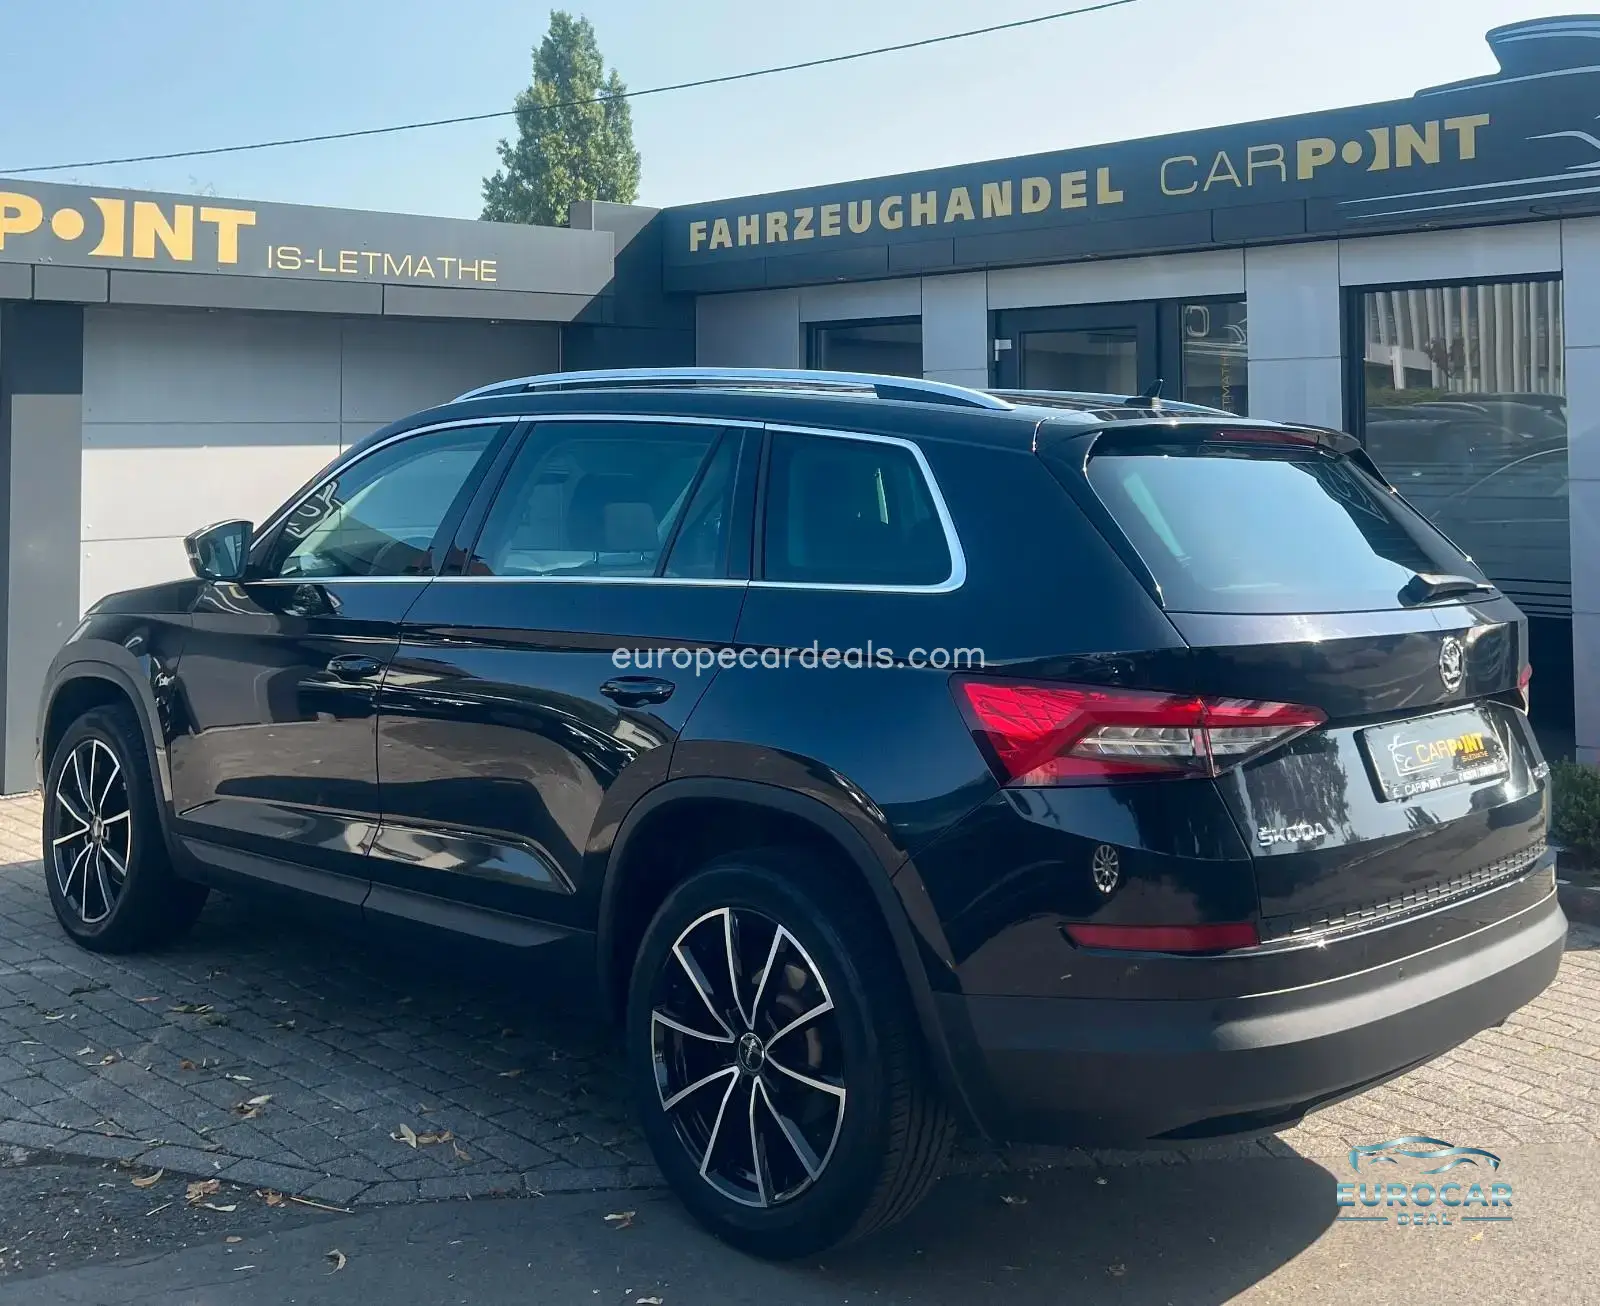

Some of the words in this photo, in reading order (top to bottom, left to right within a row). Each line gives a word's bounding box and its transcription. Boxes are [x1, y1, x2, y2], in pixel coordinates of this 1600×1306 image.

[689, 167, 1123, 252] FAHRZEUGHANDEL
[268, 245, 497, 282] IS-LETMATHE
[1257, 822, 1328, 848] ŠKODA
